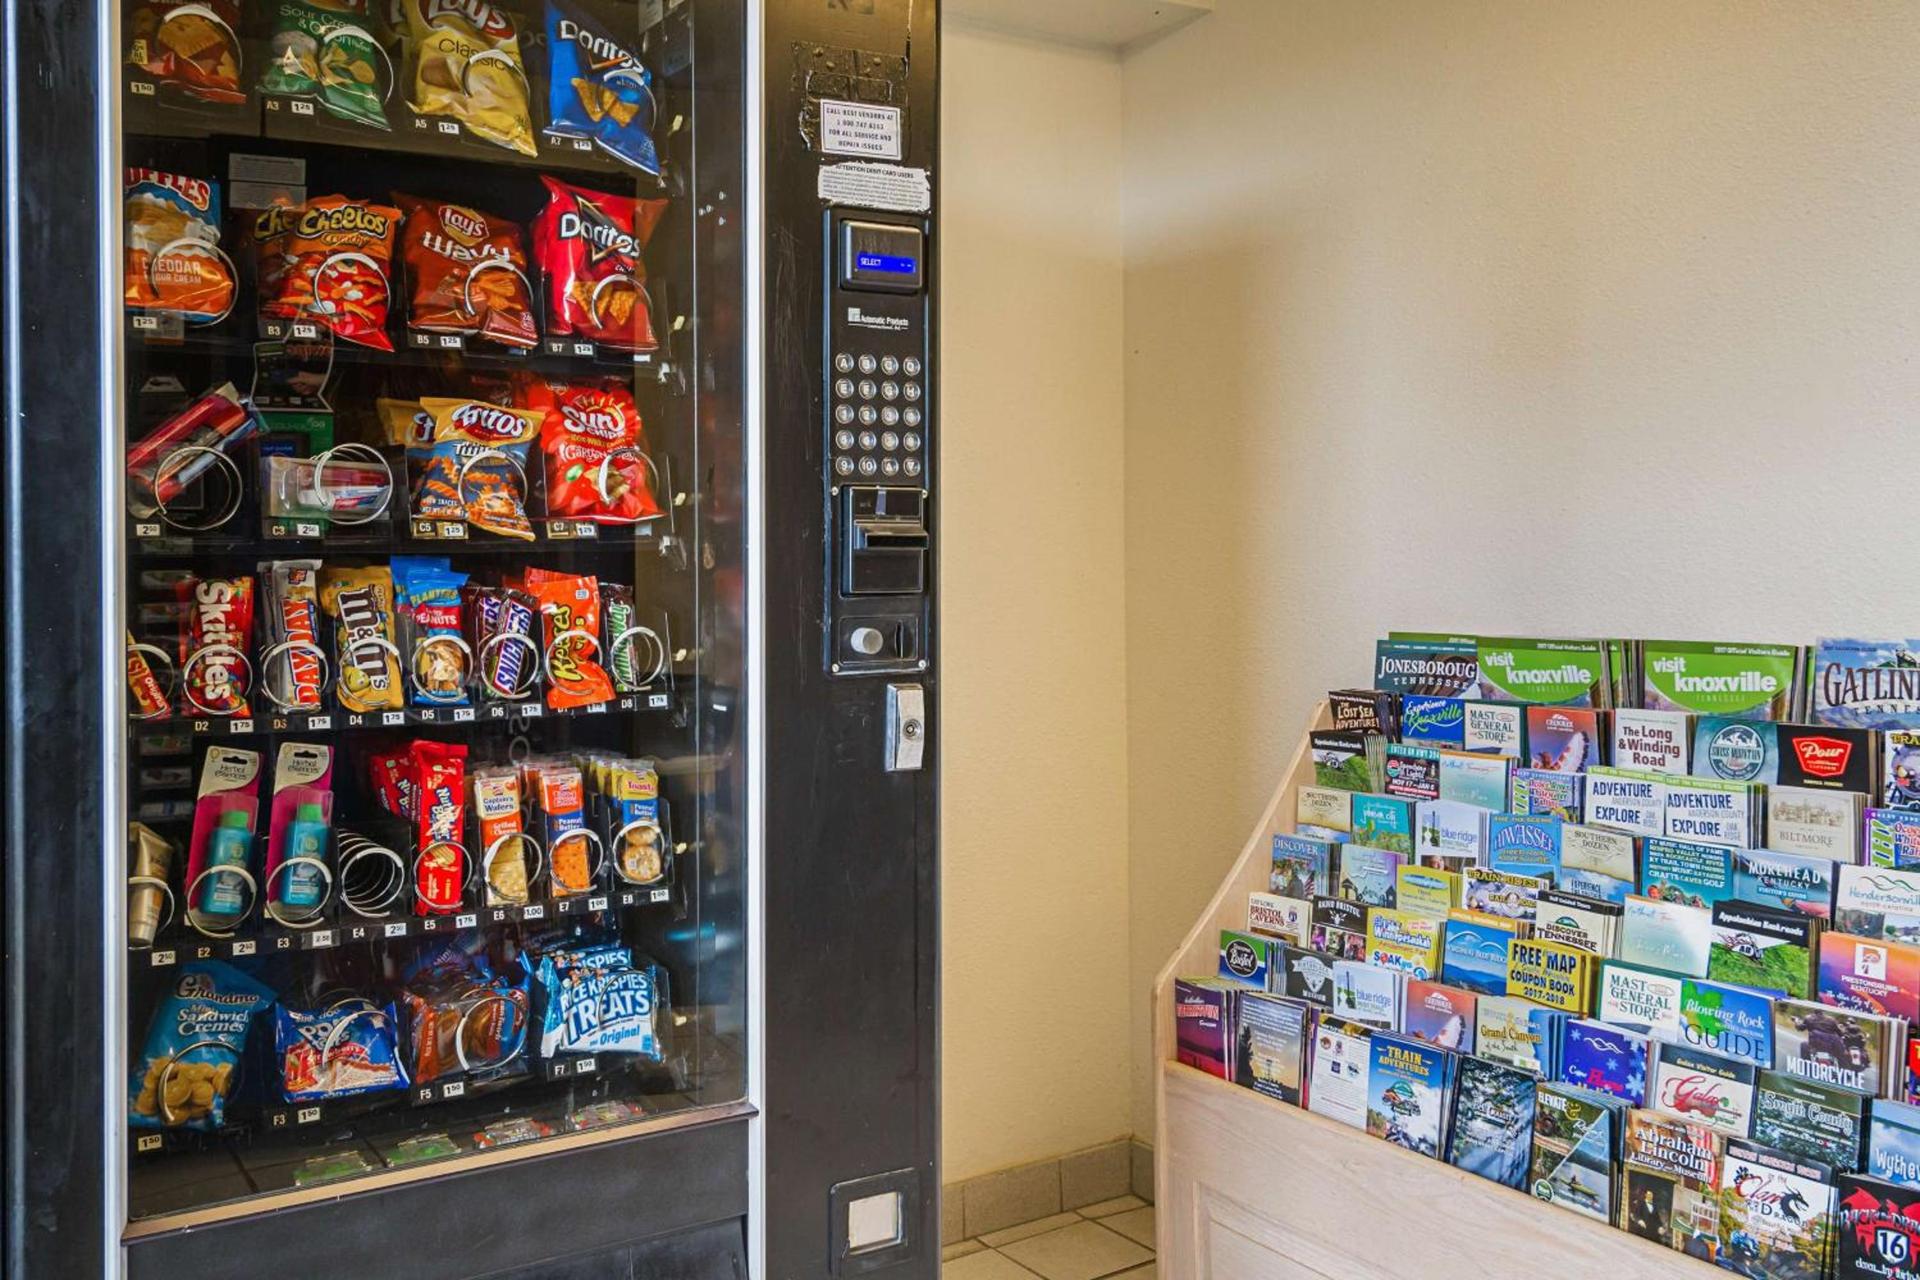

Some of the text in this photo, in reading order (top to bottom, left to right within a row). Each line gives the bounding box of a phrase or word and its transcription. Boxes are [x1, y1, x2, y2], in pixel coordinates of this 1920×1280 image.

[560, 20, 645, 74] Doritos
[266, 101, 279, 110] A3
[415, 119, 427, 129] A5
[550, 137, 561, 146] A7
[300, 205, 389, 238] Cheetos
[560, 213, 641, 257] Doritos
[268, 326, 280, 336] B3
[417, 335, 429, 344] B5
[552, 343, 563, 352] B7
[561, 406, 626, 433] Sun
[416, 612, 457, 625] PEANUTS
[196, 581, 235, 700] Skittles
[1485, 652, 1515, 667] visit
[1653, 657, 1686, 673] visit
[1506, 664, 1592, 684] knoxville
[1674, 671, 1778, 692] knoxville
[1393, 677, 1469, 690] TENNESSEE
[1823, 662, 1920, 708] GATLIN
[621, 698, 633, 708] D8
[350, 715, 362, 725] D4
[422, 709, 434, 719] D5
[491, 707, 503, 717] D6
[1337, 705, 1374, 719] LOST SEA
[1470, 709, 1495, 720] MAST
[195, 721, 208, 731] D2
[1470, 720, 1514, 734] GENERAL
[1623, 725, 1673, 741] The Long
[1477, 730, 1507, 744] STORE
[1618, 738, 1680, 759] & Winding
[1801, 742, 1845, 759] Pour
[1633, 751, 1667, 768] Road
[1592, 781, 1653, 798] ADVENTURE
[1667, 793, 1733, 809] ADVENTURE
[1595, 806, 1641, 824] EXPLORE
[1672, 818, 1721, 837] EXPLORE
[1779, 830, 1834, 846] BILTMORE
[1274, 838, 1318, 857] DISCOVER
[1467, 868, 1500, 882] TRAIN
[1648, 870, 1725, 889] CRAFTS GOLF
[1747, 860, 1822, 884] MOREHEAD
[494, 910, 505, 920] E6
[1250, 904, 1282, 917] BRISTOL
[424, 920, 436, 930] E5
[1250, 913, 1285, 927] CAVERNS
[353, 928, 365, 938] E4
[1537, 926, 1598, 953] TENNESSEE
[1546, 923, 1588, 939] DISCOVER
[1513, 942, 1542, 967] FREE
[1547, 952, 1577, 975] MAP
[1510, 969, 1576, 997] COUPON BOOK
[1610, 974, 1649, 993] MAST
[561, 973, 648, 1012] RICE KRISPIES
[1610, 986, 1672, 1010] GENERAL
[566, 990, 651, 1046] TREATS
[1619, 1001, 1661, 1021] STORE
[1686, 998, 1766, 1030] Blowing Rock
[600, 1026, 640, 1045] Original
[1481, 1024, 1507, 1040] Grand
[1685, 1023, 1766, 1063] GUIDE
[1387, 1045, 1422, 1066] TRAIN
[1786, 1055, 1865, 1091] MOTORCYCLE
[420, 1089, 432, 1099] F5
[1636, 1126, 1713, 1161] Abraham
[1640, 1140, 1707, 1173] Lincoln
[1629, 1151, 1665, 1171] Library
[1673, 1162, 1712, 1185] Museum
[1879, 1230, 1905, 1260] 16
